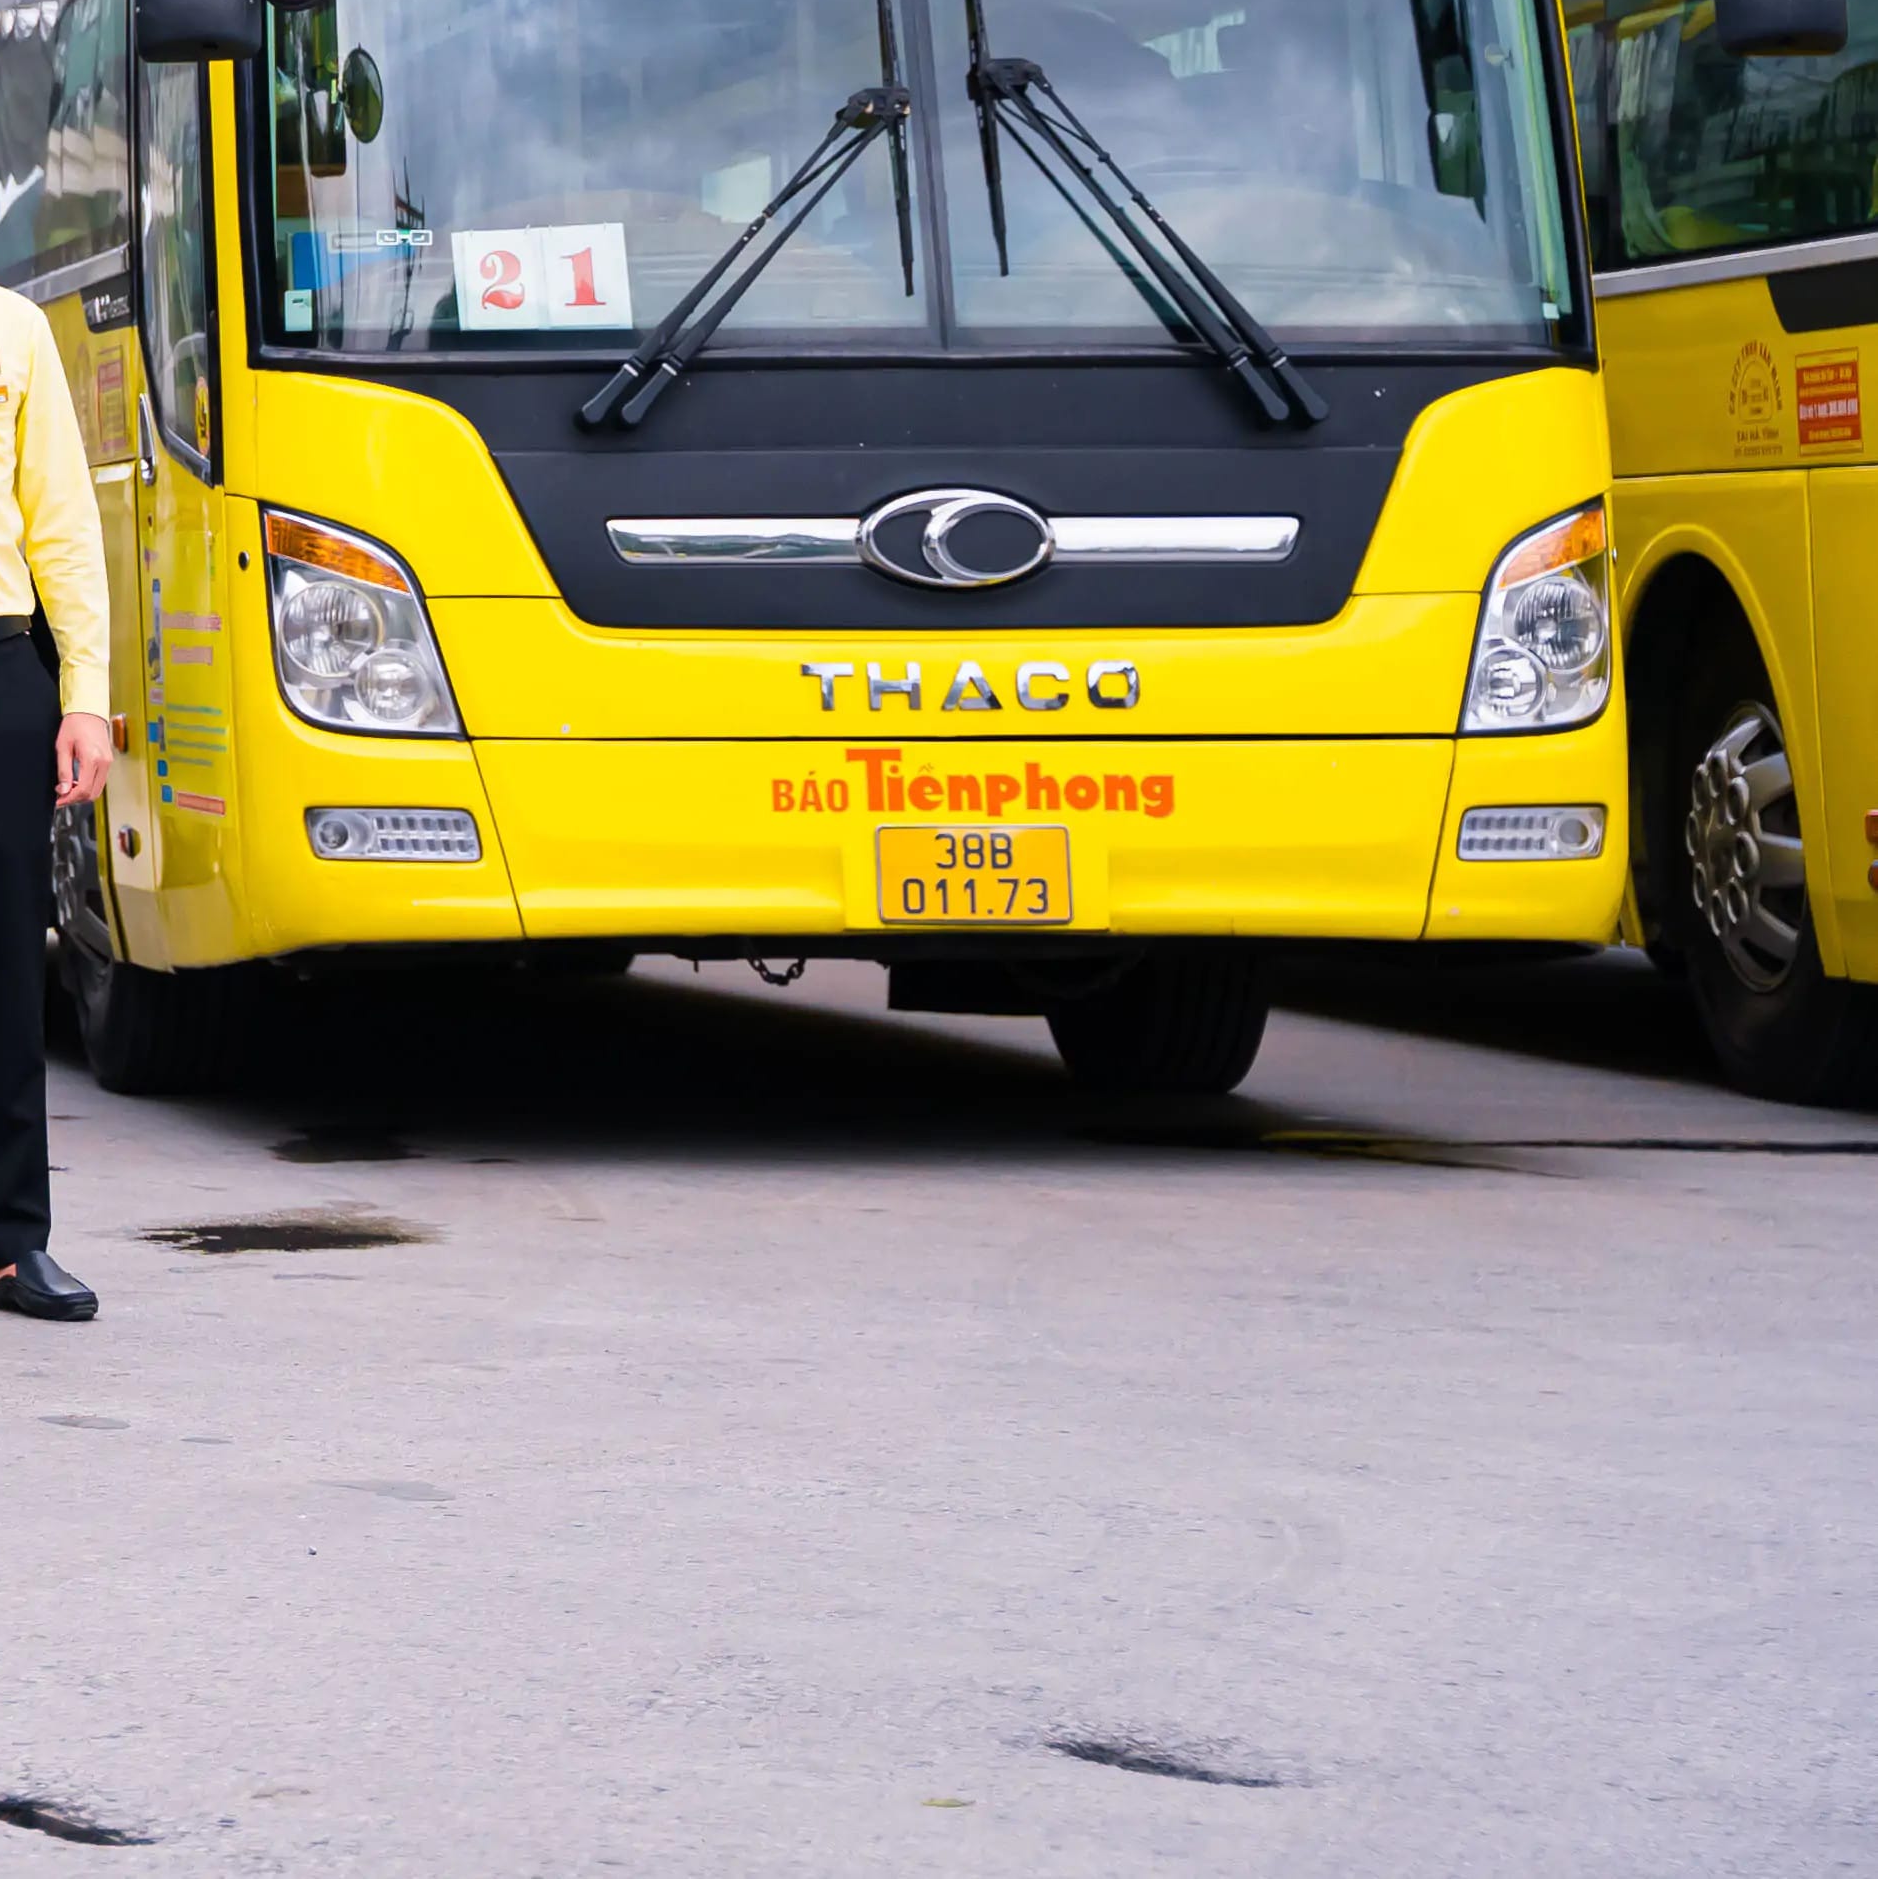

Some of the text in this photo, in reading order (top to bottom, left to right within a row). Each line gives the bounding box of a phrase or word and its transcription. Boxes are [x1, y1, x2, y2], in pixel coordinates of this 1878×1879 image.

[479, 247, 607, 310] 21
[800, 660, 1141, 712] THACO
[772, 770, 849, 812] BÁO
[934, 833, 1012, 870] 38B
[902, 878, 1049, 915] 011.73
